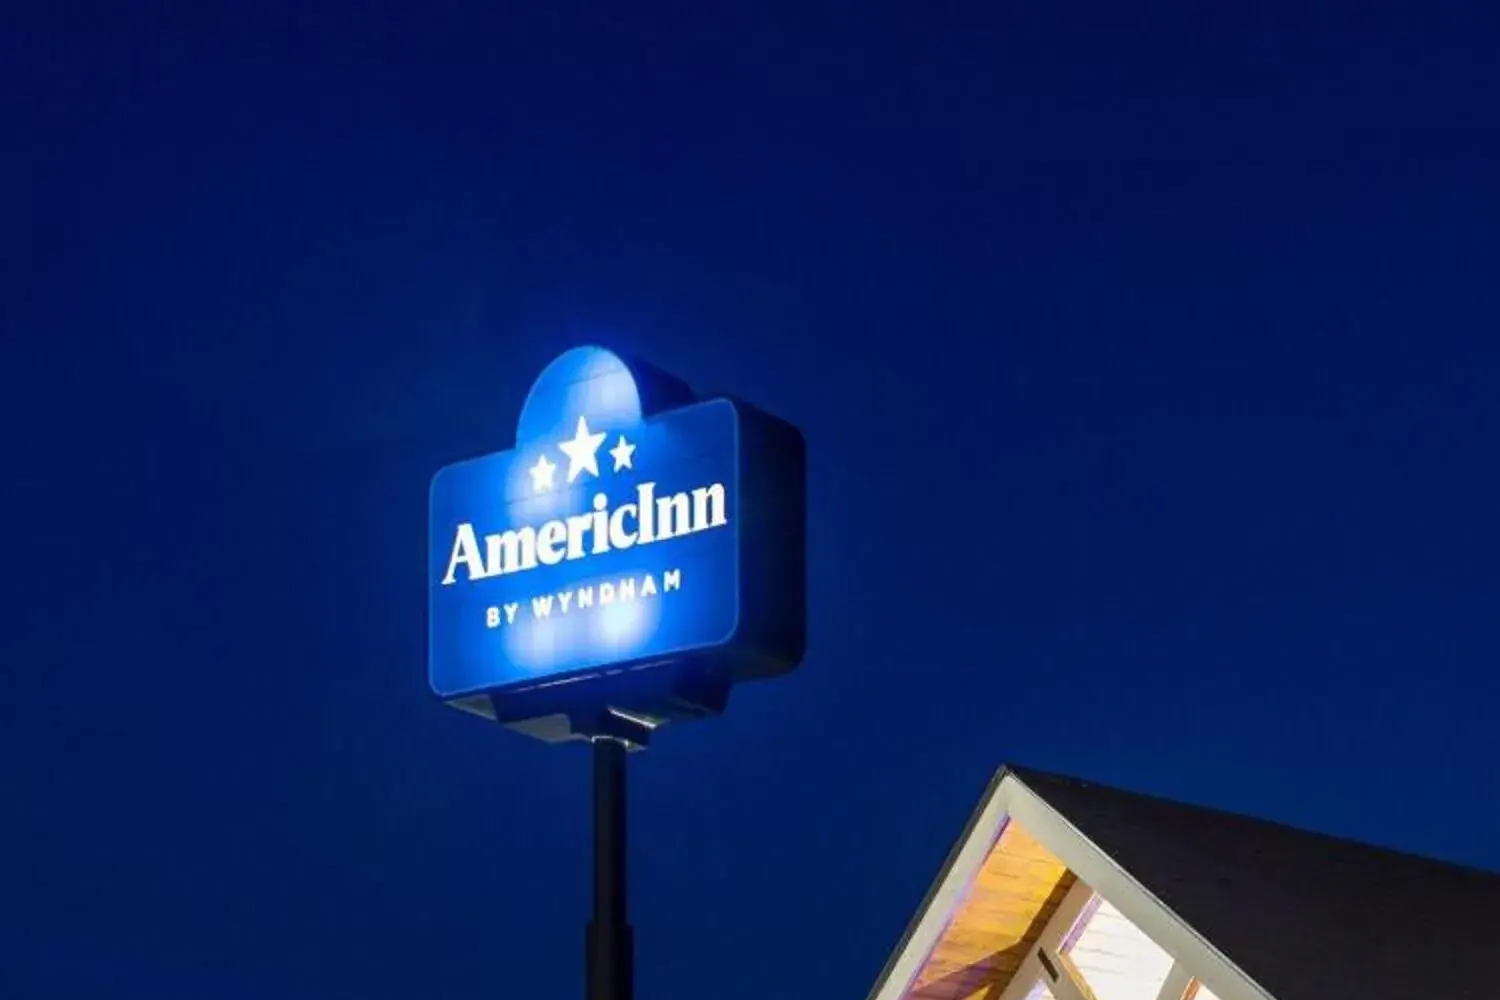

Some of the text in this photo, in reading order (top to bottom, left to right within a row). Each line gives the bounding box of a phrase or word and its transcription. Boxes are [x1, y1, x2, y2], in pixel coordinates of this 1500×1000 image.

[441, 481, 727, 586] AmericInn
[486, 569, 682, 628] BY WYNDHAM
